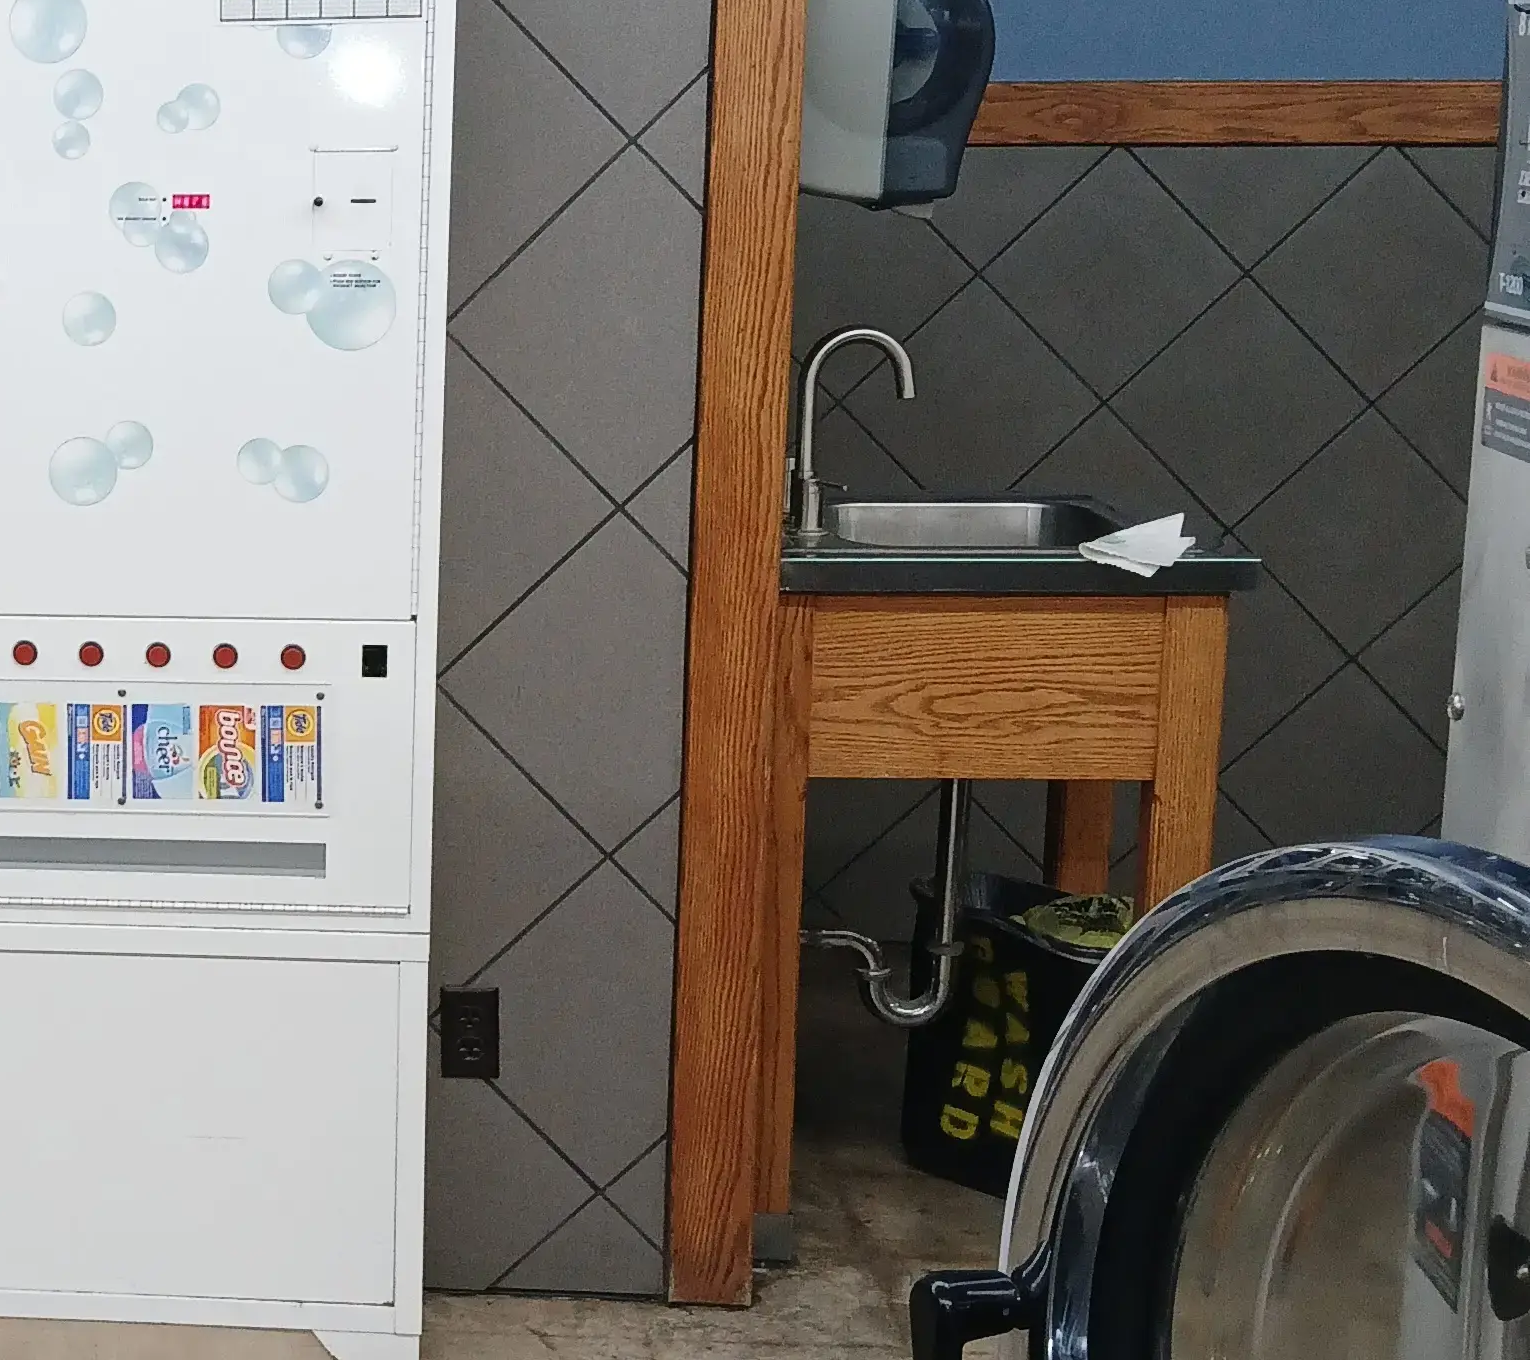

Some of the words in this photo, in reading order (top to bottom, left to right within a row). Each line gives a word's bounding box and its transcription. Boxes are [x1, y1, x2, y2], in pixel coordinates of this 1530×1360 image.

[98, 712, 113, 733] Tide
[292, 713, 307, 734] Tide
[155, 725, 179, 774] cheer
[216, 710, 247, 786] bounce
